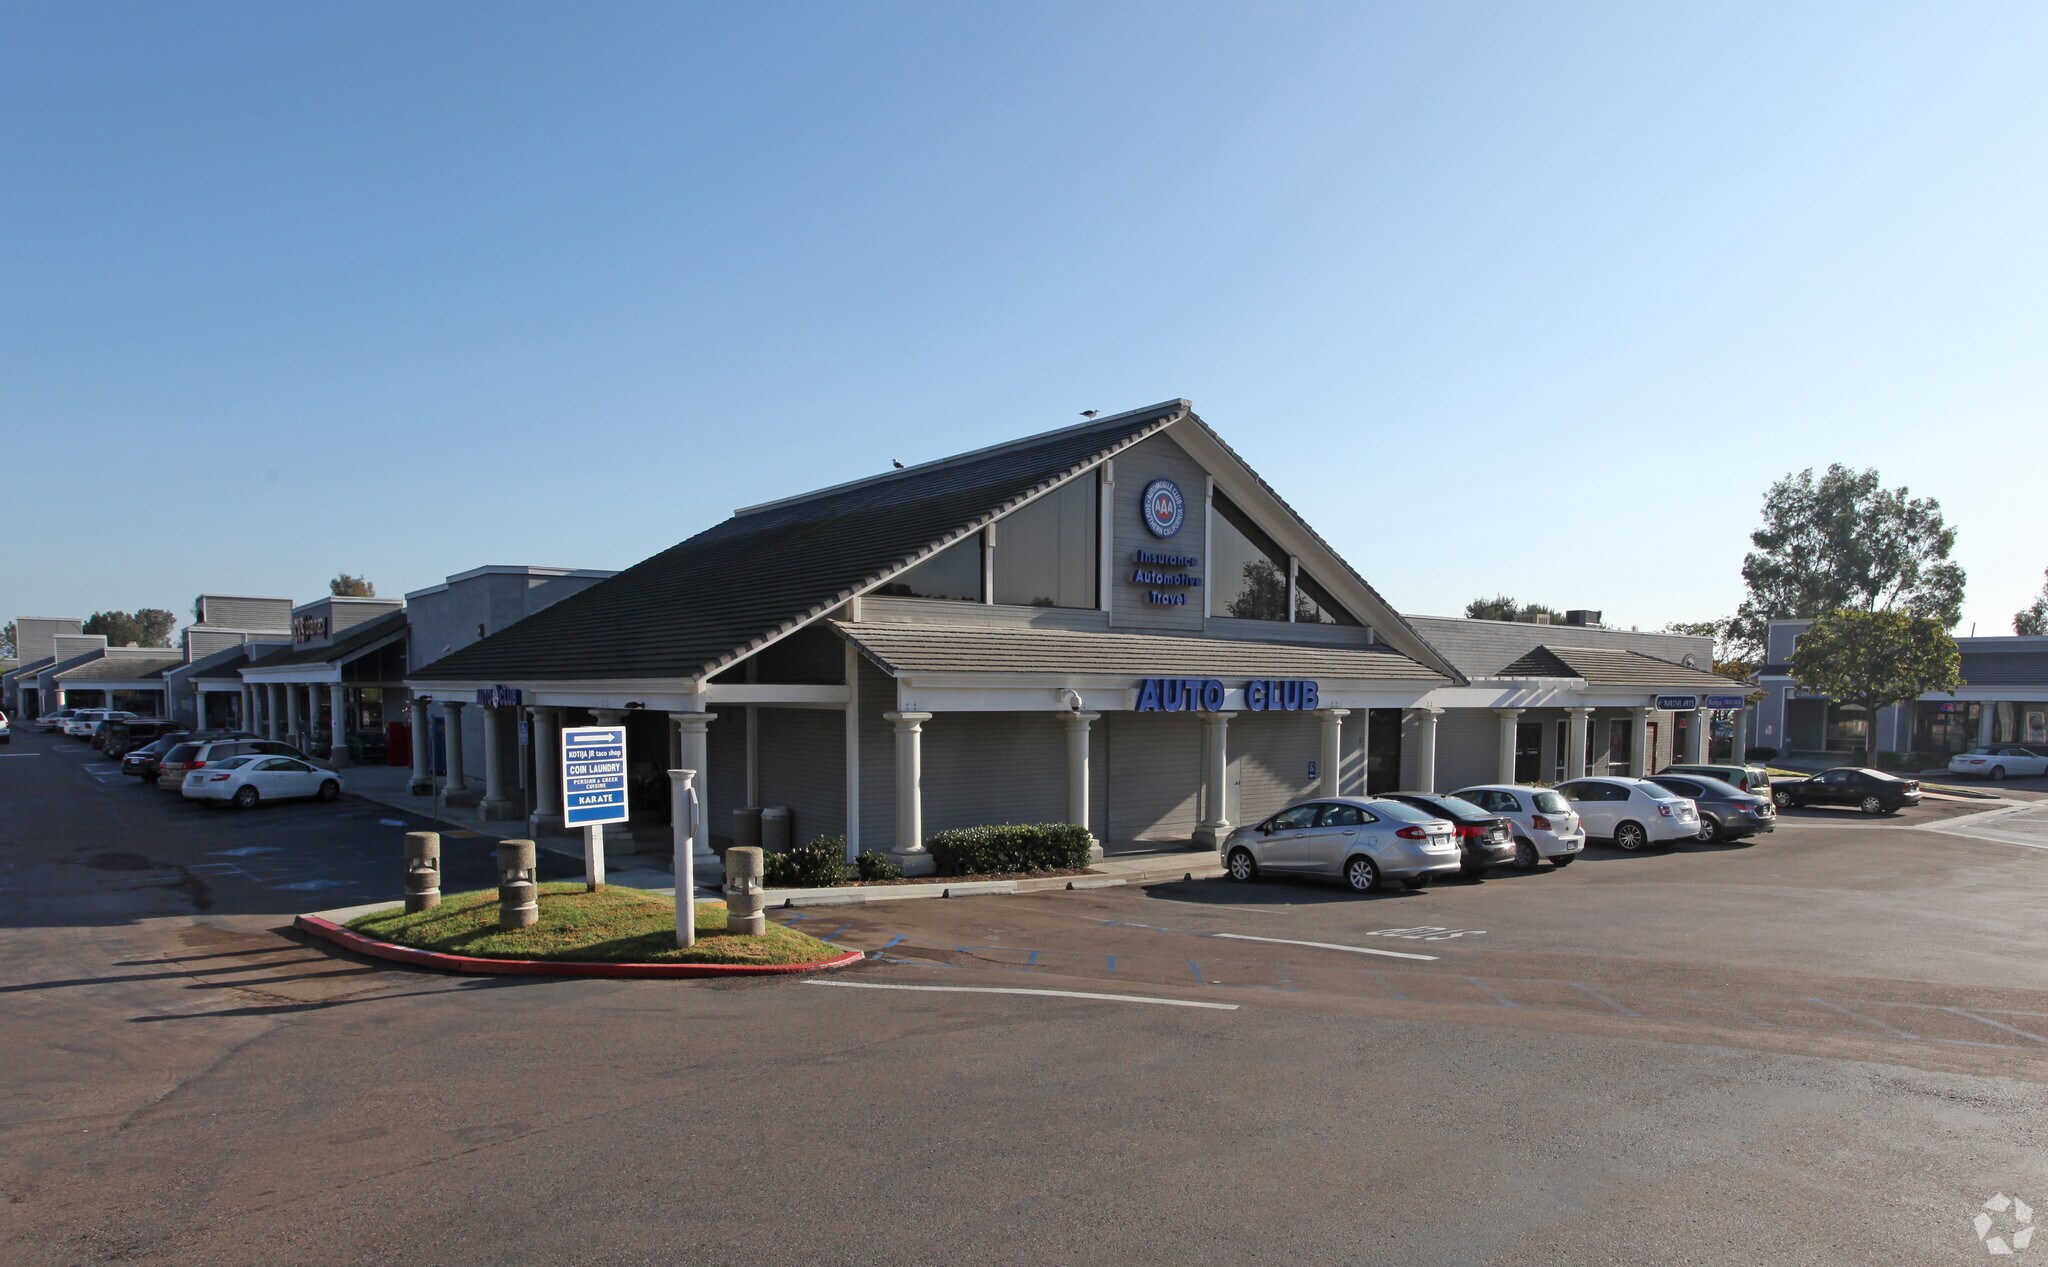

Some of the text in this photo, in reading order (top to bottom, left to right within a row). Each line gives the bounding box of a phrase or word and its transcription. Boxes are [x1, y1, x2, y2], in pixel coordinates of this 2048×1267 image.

[1146, 480, 1173, 500] AUTOMOBILE
[1155, 499, 1173, 515] AAA
[1145, 503, 1184, 536] SOUTHERN CALIFORNIA
[1138, 550, 1199, 567] Insurance
[1134, 569, 1202, 587] Automotive
[1148, 591, 1187, 606] Travel
[500, 689, 517, 706] CLUB
[1135, 679, 1319, 712] AUTO CLUB
[569, 750, 588, 759] KOTIJA
[589, 750, 595, 759] JR
[609, 749, 621, 758] shop
[570, 763, 620, 775] COIN LAUNDRY
[579, 794, 613, 805] KARATE
